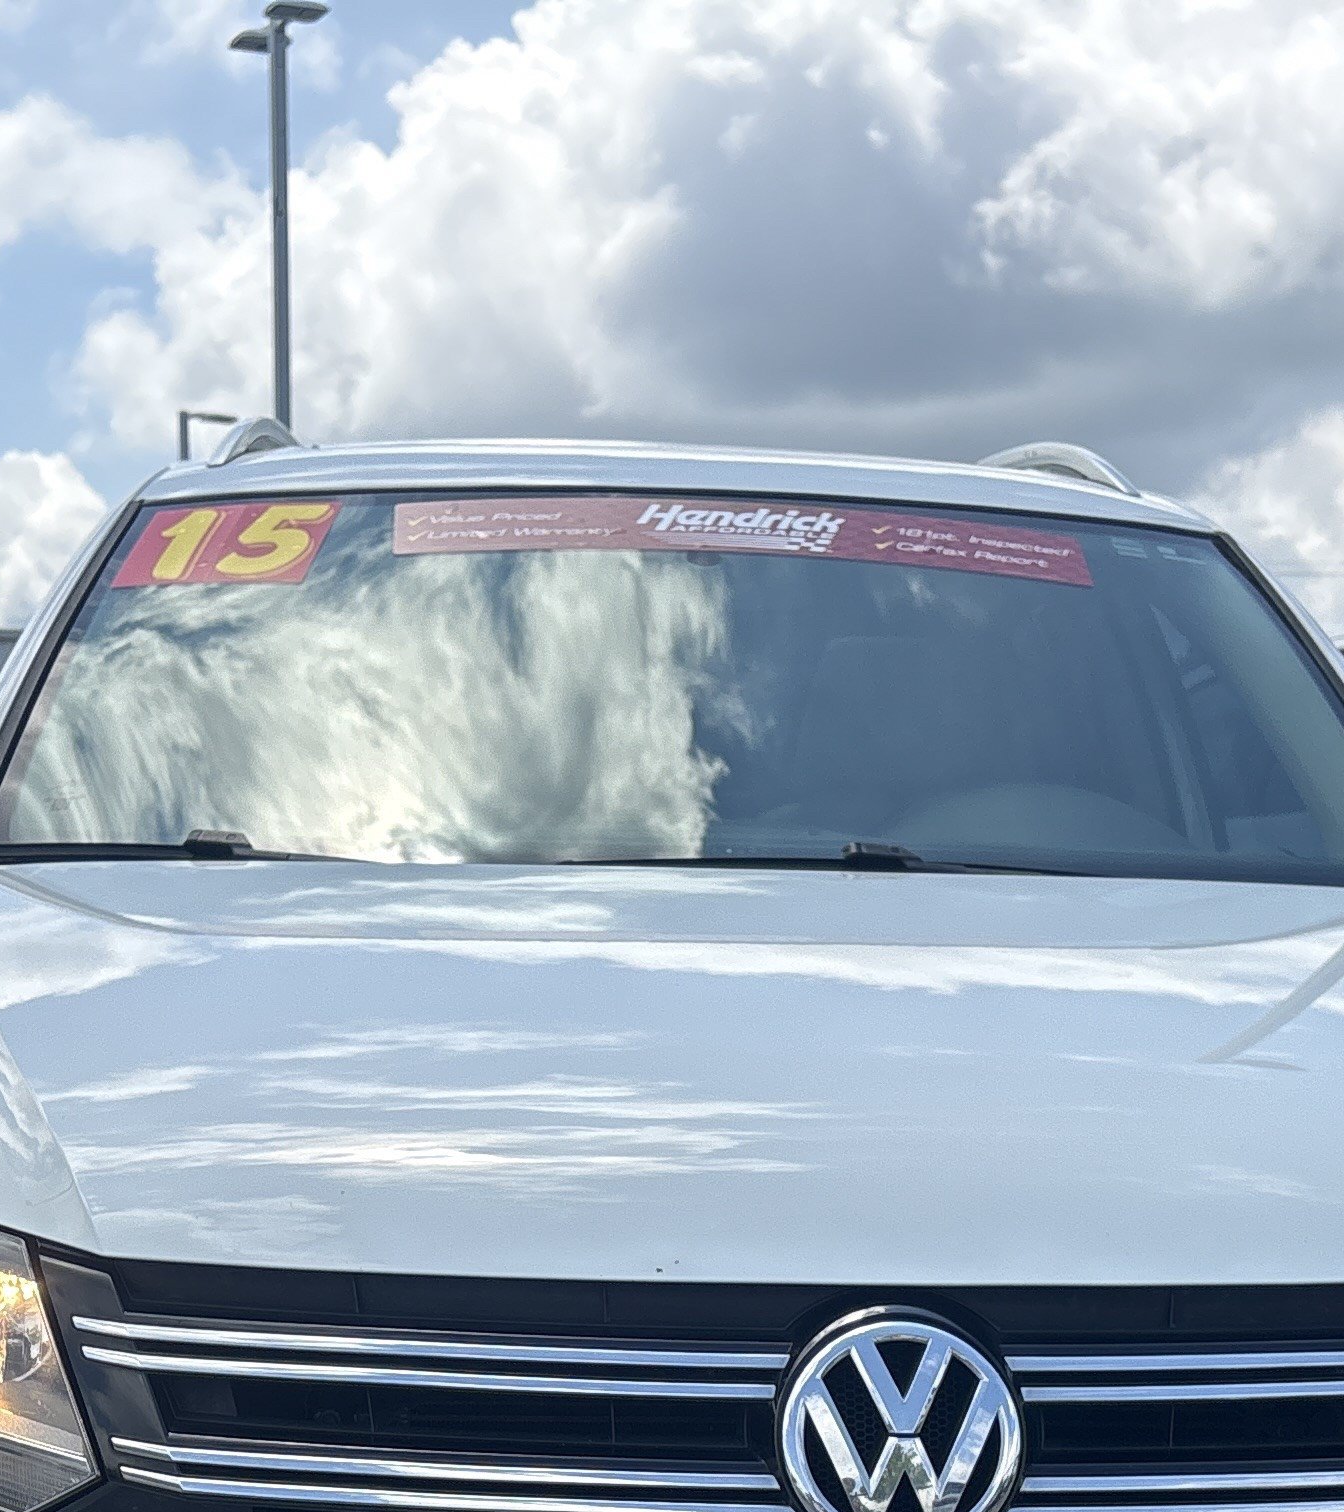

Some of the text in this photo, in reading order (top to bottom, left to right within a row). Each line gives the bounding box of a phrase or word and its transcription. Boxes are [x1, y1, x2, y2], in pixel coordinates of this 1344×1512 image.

[636, 503, 846, 534] Hendrick
[152, 503, 335, 581] 15
[670, 524, 837, 540] AFFORDABLE
[969, 535, 1072, 557] Inspected
[973, 550, 1049, 568] Report
